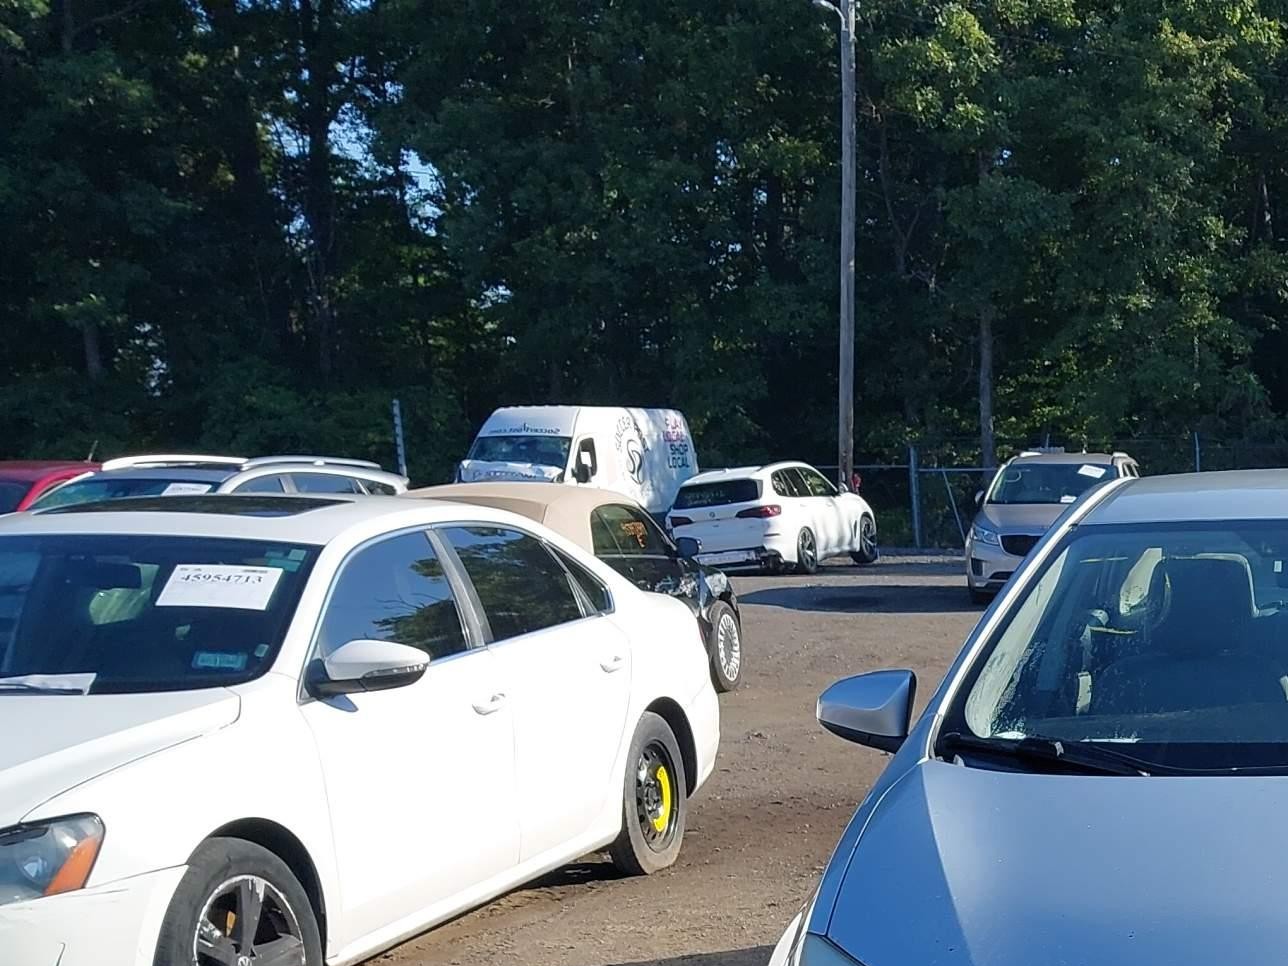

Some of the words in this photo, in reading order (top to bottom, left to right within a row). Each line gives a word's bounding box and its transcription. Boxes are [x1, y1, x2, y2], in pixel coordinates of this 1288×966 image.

[669, 443, 689, 456] SHOP
[667, 456, 690, 469] LOCAL
[181, 574, 264, 583] 45954713
